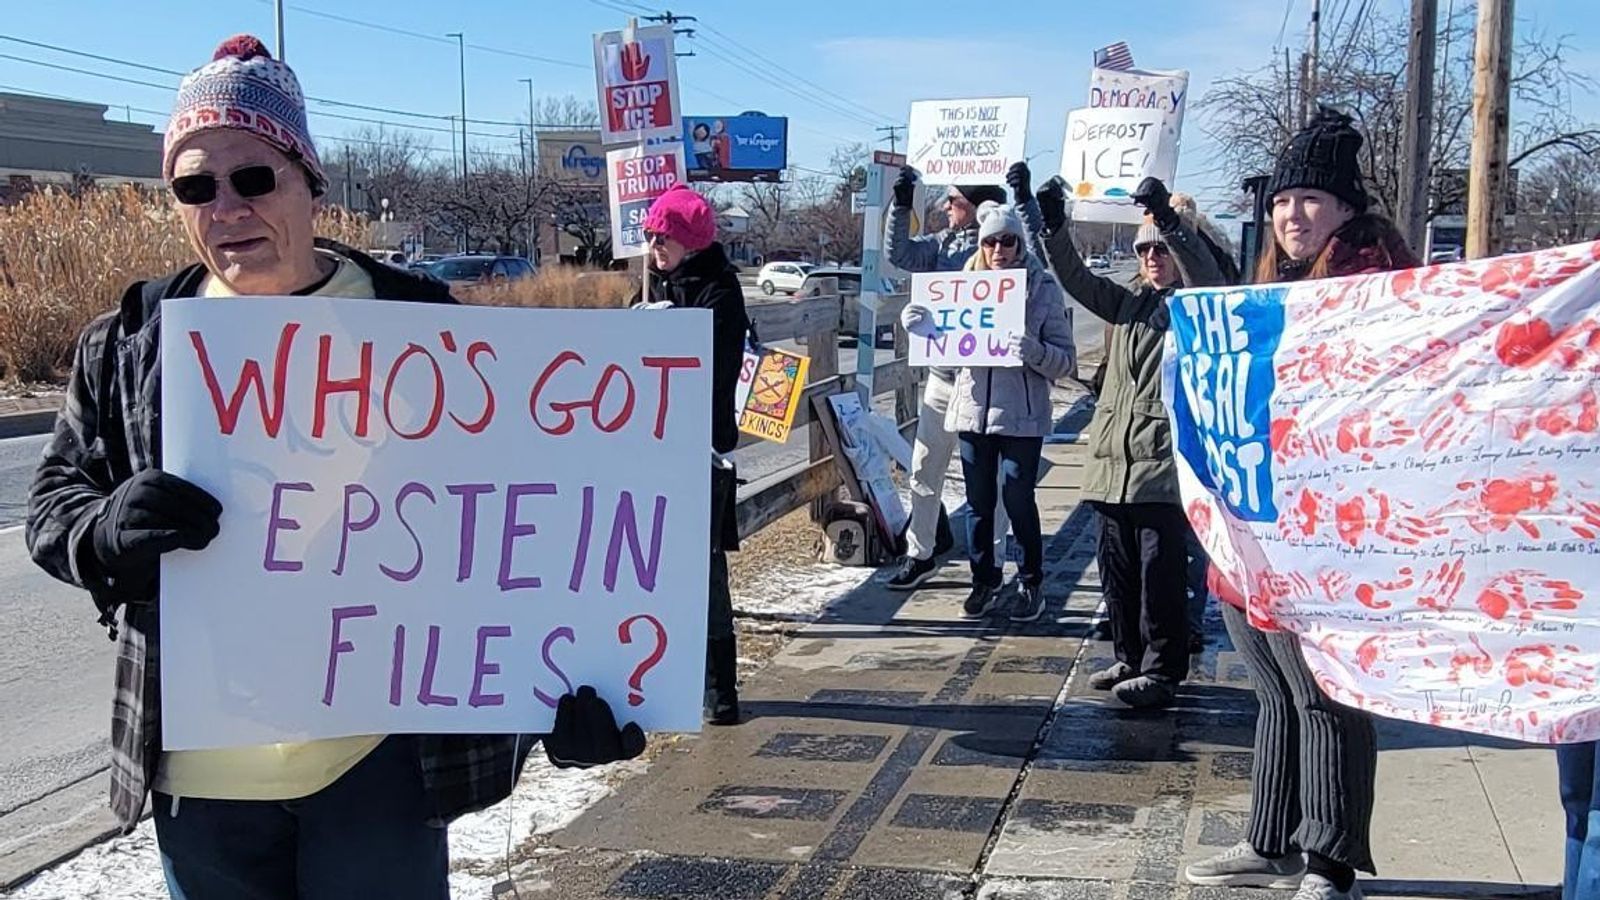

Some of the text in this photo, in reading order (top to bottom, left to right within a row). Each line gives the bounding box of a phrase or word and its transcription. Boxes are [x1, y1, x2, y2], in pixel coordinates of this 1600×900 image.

[612, 84, 662, 110] STOP
[1091, 87, 1185, 114] DEMOCRACY
[623, 107, 656, 131] ICE
[939, 105, 1001, 121] THIS IS NOT
[937, 123, 1007, 139] WHO WE ARE!
[1072, 119, 1154, 142] DEFROST
[625, 156, 666, 177] STOP
[926, 158, 1008, 175] DO YOUR JOB!
[1081, 147, 1150, 181] ICE!
[618, 173, 675, 196] TRUMP
[928, 278, 1016, 303] STOP
[935, 307, 995, 331] ICE
[1182, 292, 1249, 354] THE
[926, 332, 1011, 358] NOW
[188, 322, 702, 440] WHO'S GOT
[1180, 351, 1255, 438] REAL
[263, 482, 668, 593] EPSTEIN
